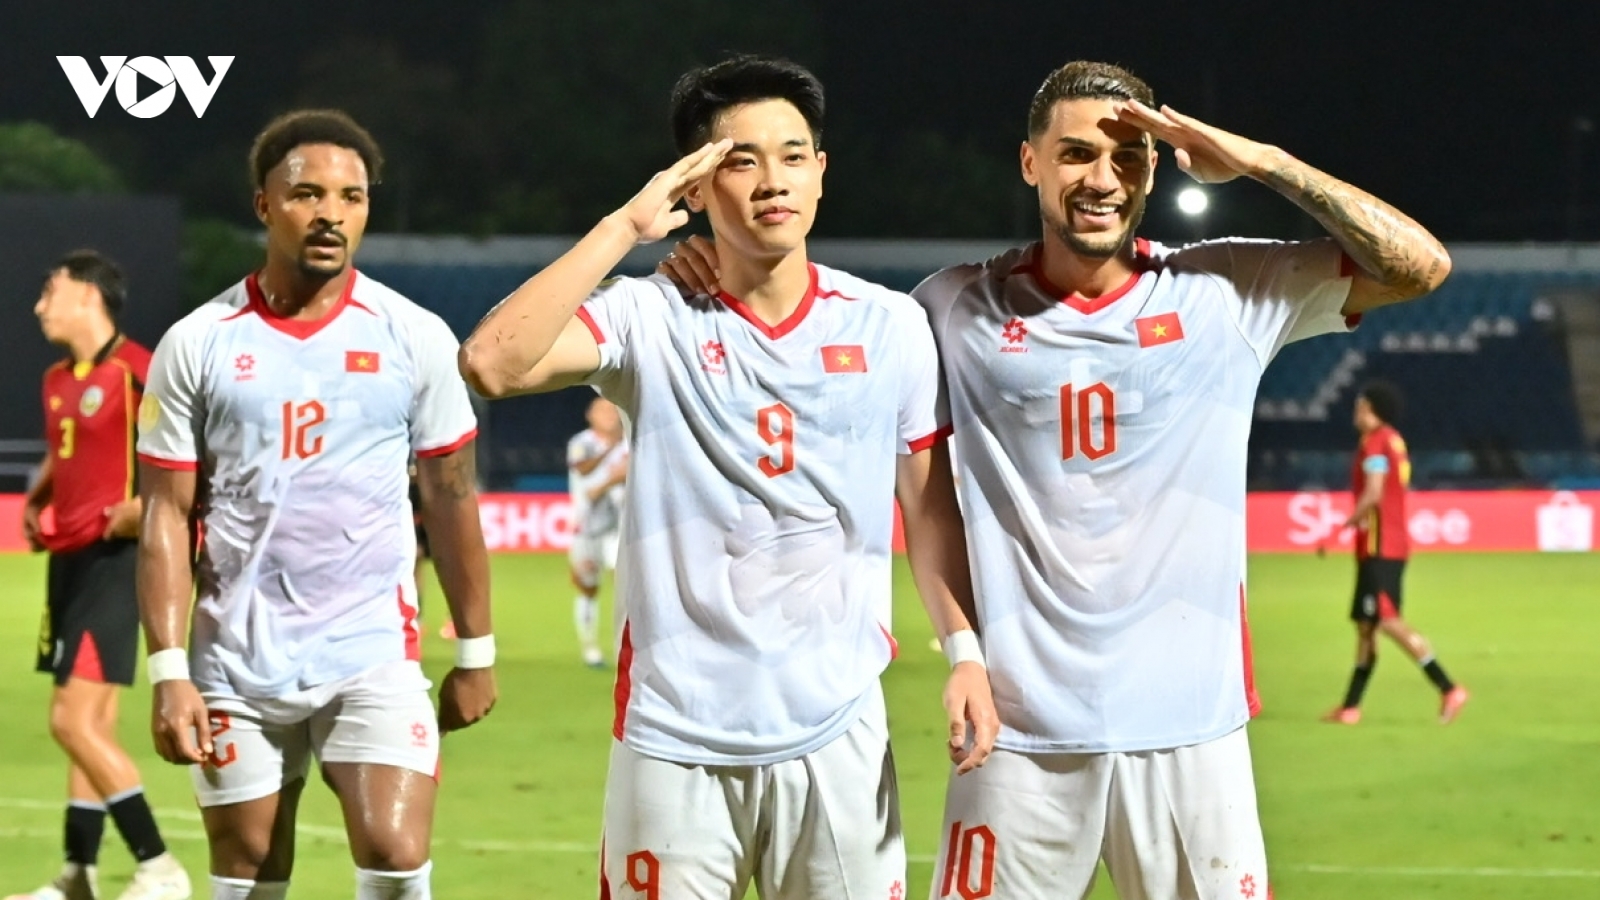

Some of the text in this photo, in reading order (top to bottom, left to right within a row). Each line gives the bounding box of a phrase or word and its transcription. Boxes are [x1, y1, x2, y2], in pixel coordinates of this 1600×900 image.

[58, 417, 75, 459] 3
[282, 399, 325, 460] 12
[757, 402, 795, 478] 9
[1060, 381, 1117, 462] 10
[626, 850, 660, 900] 9
[941, 821, 995, 900] 10
